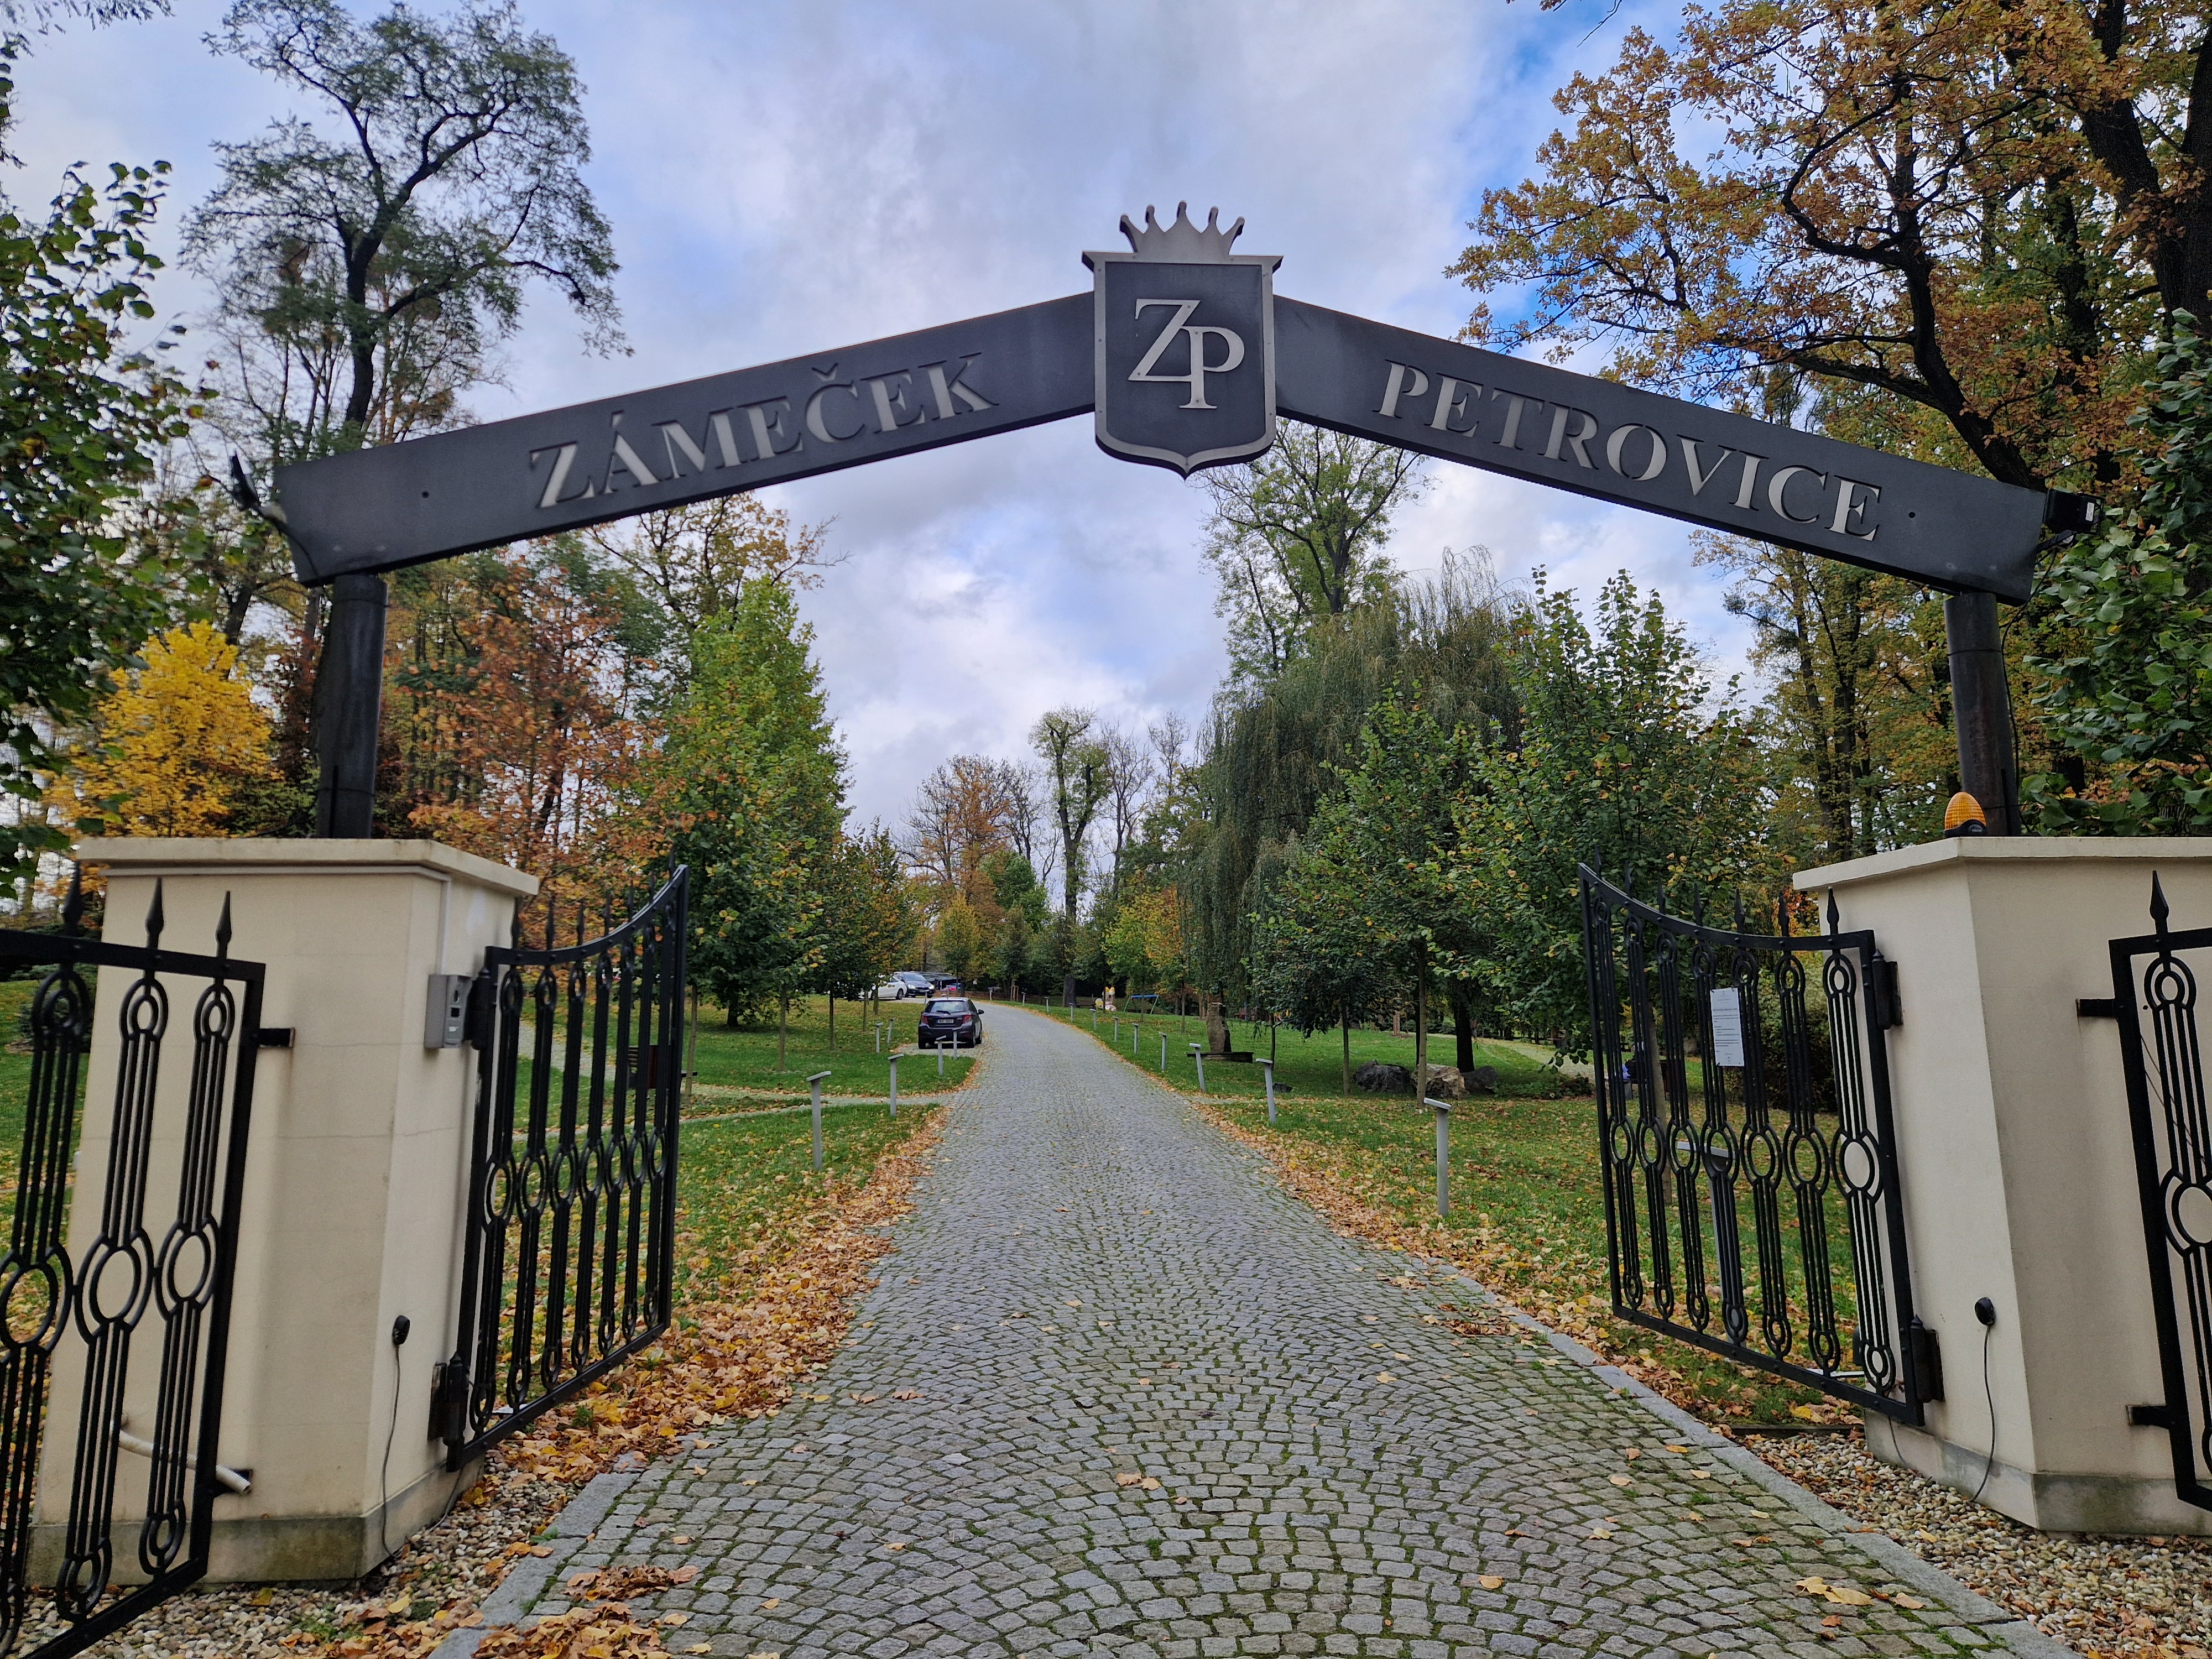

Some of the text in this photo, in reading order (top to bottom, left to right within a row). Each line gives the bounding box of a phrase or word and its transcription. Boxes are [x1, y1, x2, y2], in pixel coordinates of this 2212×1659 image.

[1128, 298, 1245, 409] ZP
[529, 352, 1882, 541] ZÁMEČEK PETROVICE
